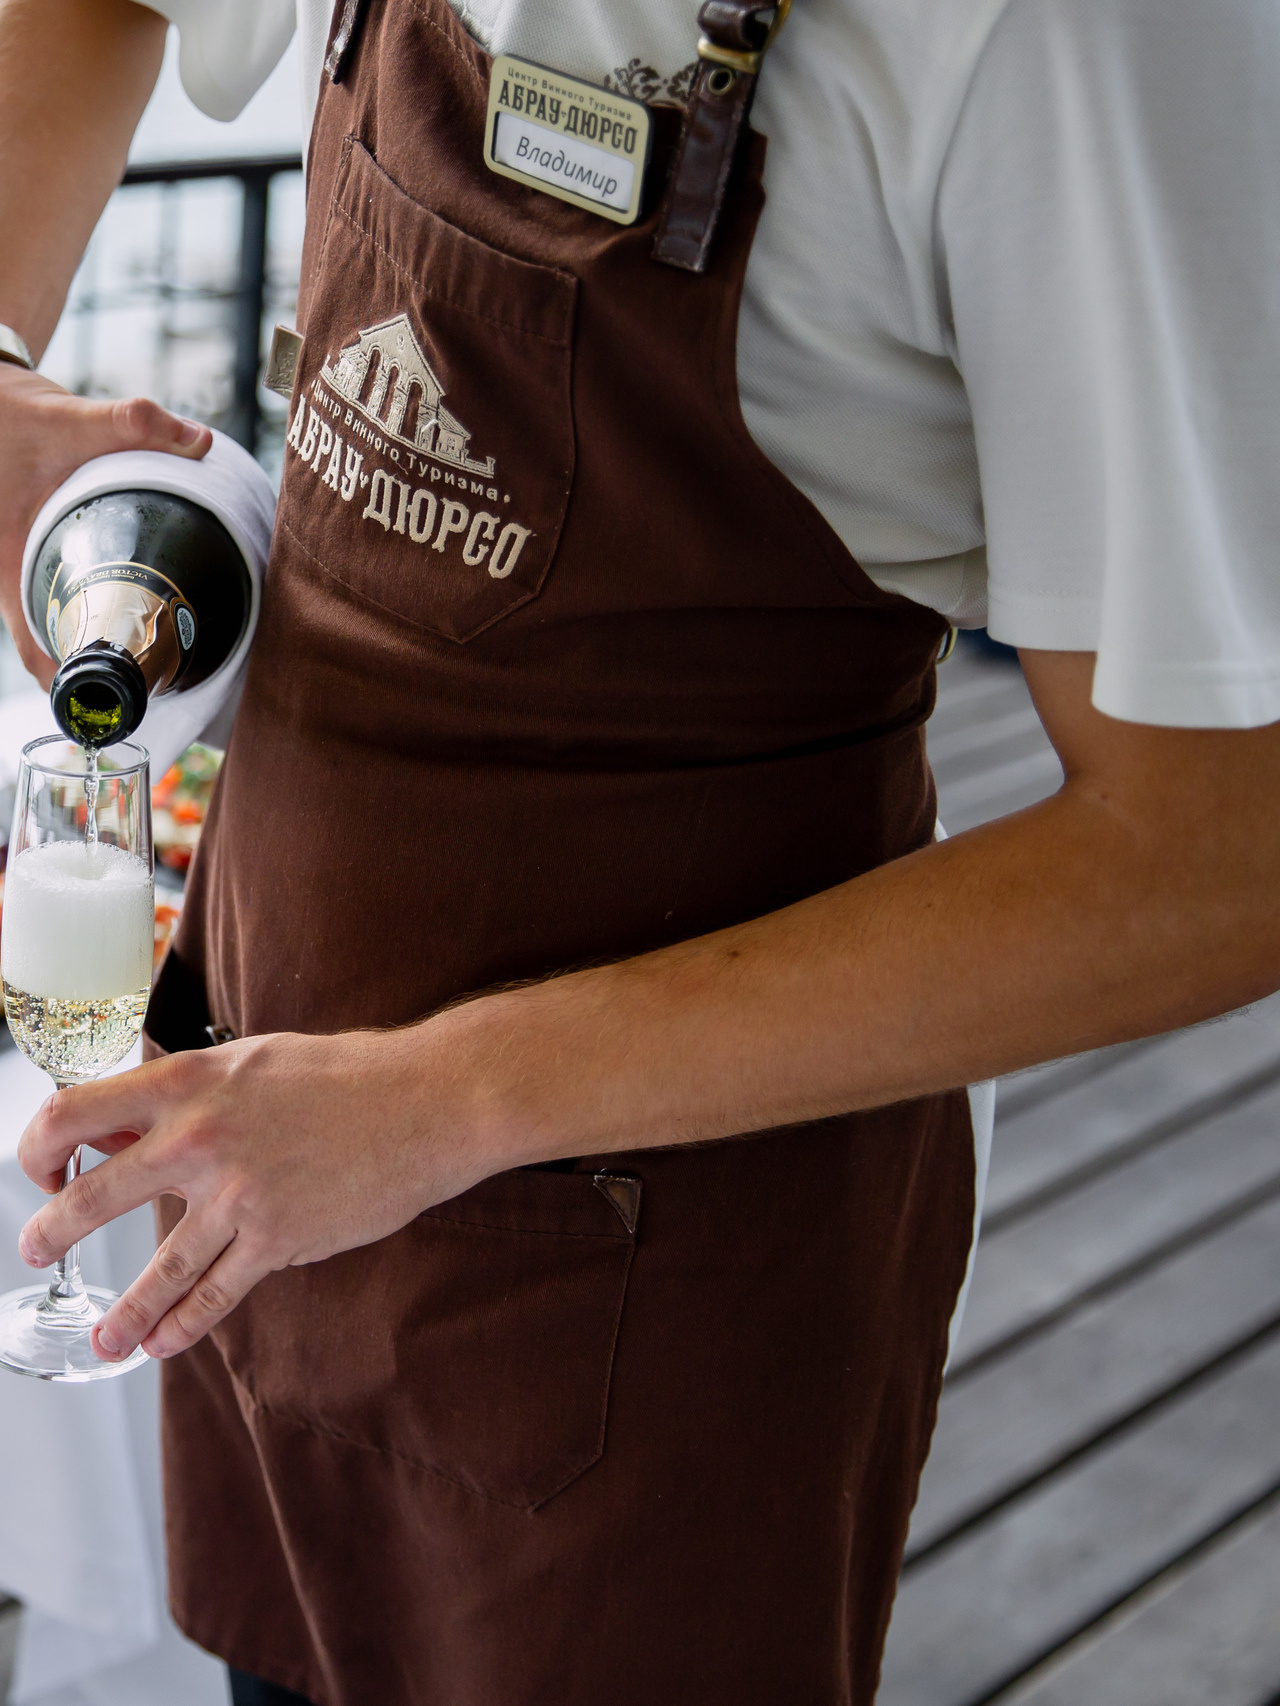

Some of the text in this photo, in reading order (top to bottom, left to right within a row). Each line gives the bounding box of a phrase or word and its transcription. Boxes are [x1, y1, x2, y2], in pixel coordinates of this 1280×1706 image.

[508, 67, 632, 121] Центр Винного Туризма
[516, 136, 618, 197] Владимир
[344, 408, 400, 461] Винного
[111, 569, 148, 581] VICTOR
